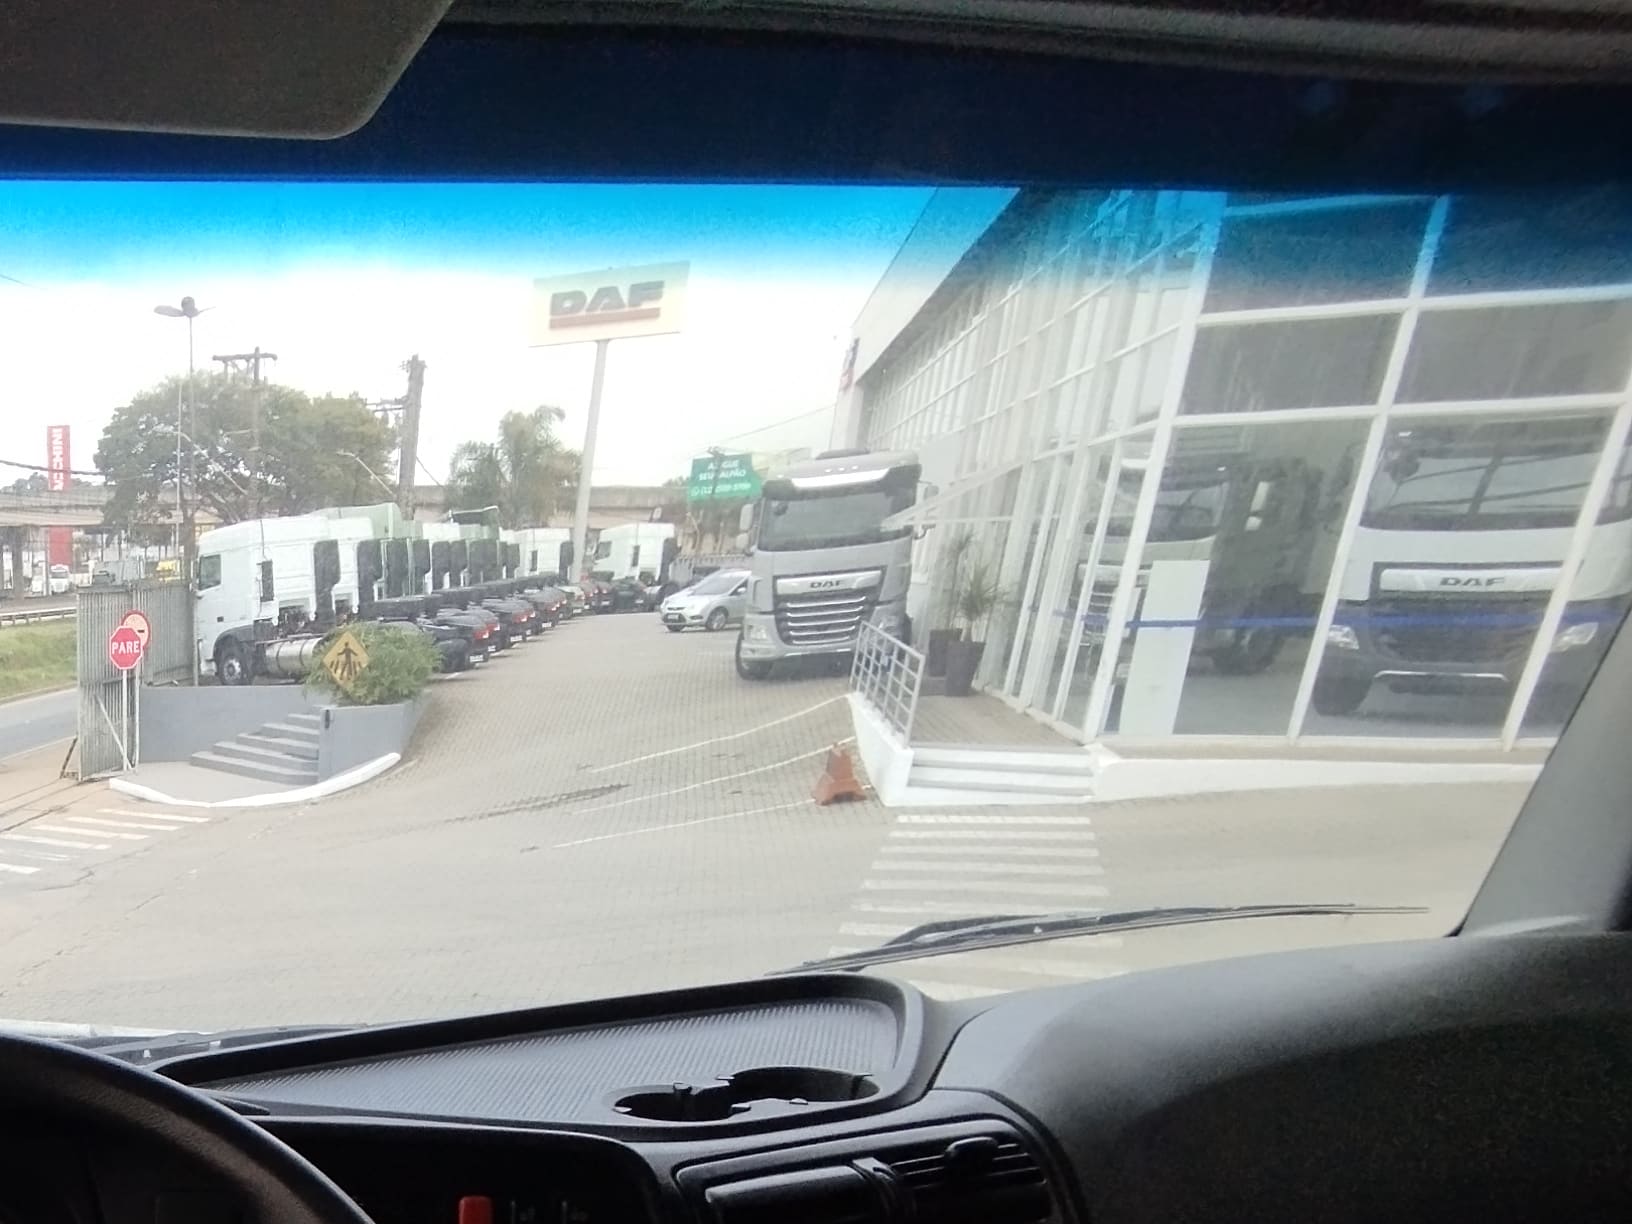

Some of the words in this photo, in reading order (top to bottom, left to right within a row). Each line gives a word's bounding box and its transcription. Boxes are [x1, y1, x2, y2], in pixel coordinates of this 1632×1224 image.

[550, 280, 665, 316] DAF
[707, 459, 740, 470] AGUE
[809, 578, 846, 590] DAF
[1440, 577, 1505, 587] DAF
[111, 640, 140, 655] PARE
